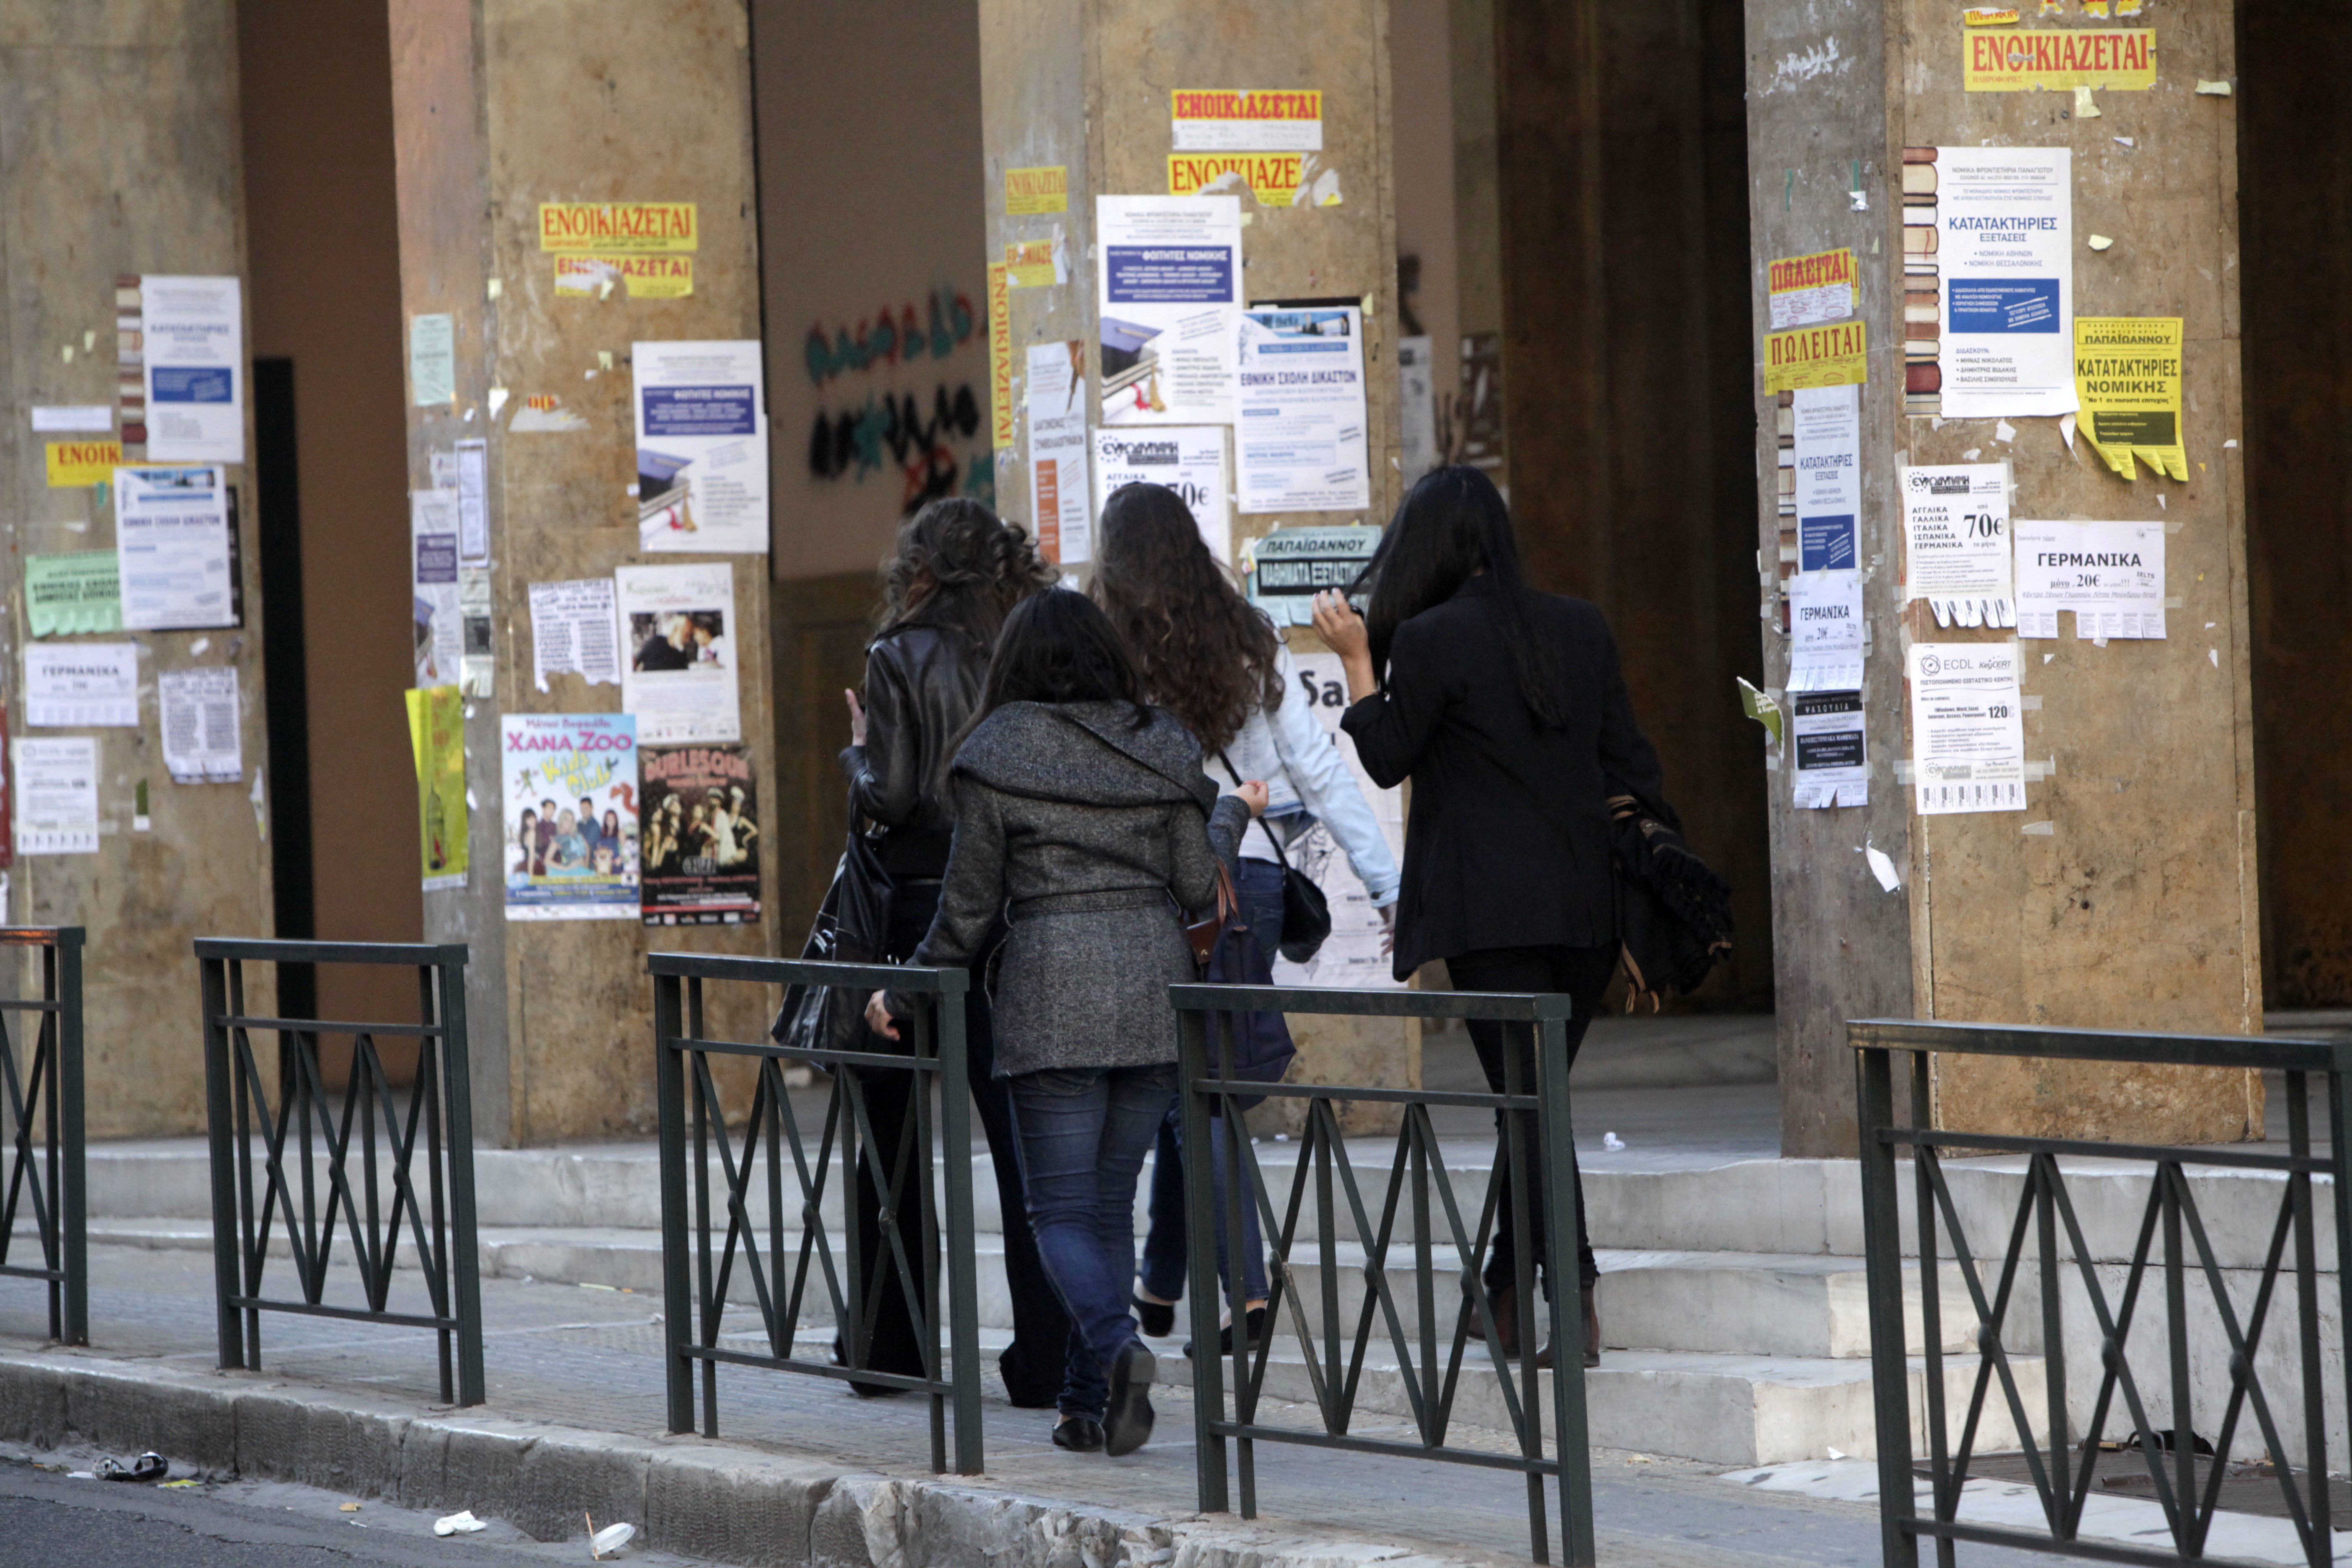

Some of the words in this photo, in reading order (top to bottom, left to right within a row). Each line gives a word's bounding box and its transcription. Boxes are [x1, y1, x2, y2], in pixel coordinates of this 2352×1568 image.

[1973, 34, 2148, 72] ΕΝΟΙΚΙΑΖΕΤΑΙ
[544, 207, 691, 237] ΕΝΟΙΚΙΑΖΕΤΑΙ
[1949, 217, 2057, 230] ΚΑΤΑΤΑΚΤΗΡΙΕΣ
[1980, 233, 2027, 242] ΕΞΕΤΑΣΕΙΣ
[1772, 251, 1849, 291] ΠΩΛΕΙΤΑΙ
[1772, 325, 1861, 365] ΠΩΛΕΙΤΑΙ
[2085, 335, 2171, 344] ΠΑΠΑΪΩΑΝΝΟΥ
[995, 267, 1011, 440] ΕΝΟΙΚΙΑΖΕΤΑΙ
[2078, 359, 2177, 377] ΚΑΤΑΤΑΚΤΗΡΙΕΣ
[2086, 381, 2166, 392] ΝΟΜΙΚΗΣ
[58, 444, 119, 465] ΕΝΟΙΚ
[1800, 454, 1852, 470] ΚΑΤΑΤΑΚΤΗΡΙΕΣ
[1816, 471, 1838, 480] ΕΞΕΤΑΣΕΙΣ
[1964, 513, 2004, 538] 70€
[1266, 538, 1366, 552] ΠΑΠΑΪΩΑΝΝΟΥ
[2038, 553, 2142, 566] ΓΕΡΜΑΝΙΚΑ
[2050, 580, 2070, 588] μόνο
[2077, 574, 2101, 587] 20€
[1800, 605, 1849, 621] ΓΕΡΜΑΝΙΚΑ
[1817, 627, 1828, 640] 20€
[1944, 660, 1973, 670] ECDL
[1979, 660, 2012, 670] KeyCERT
[507, 732, 572, 751] XANA
[578, 731, 632, 750] ZOO
[541, 748, 589, 782] Kids
[567, 763, 610, 797] Club
